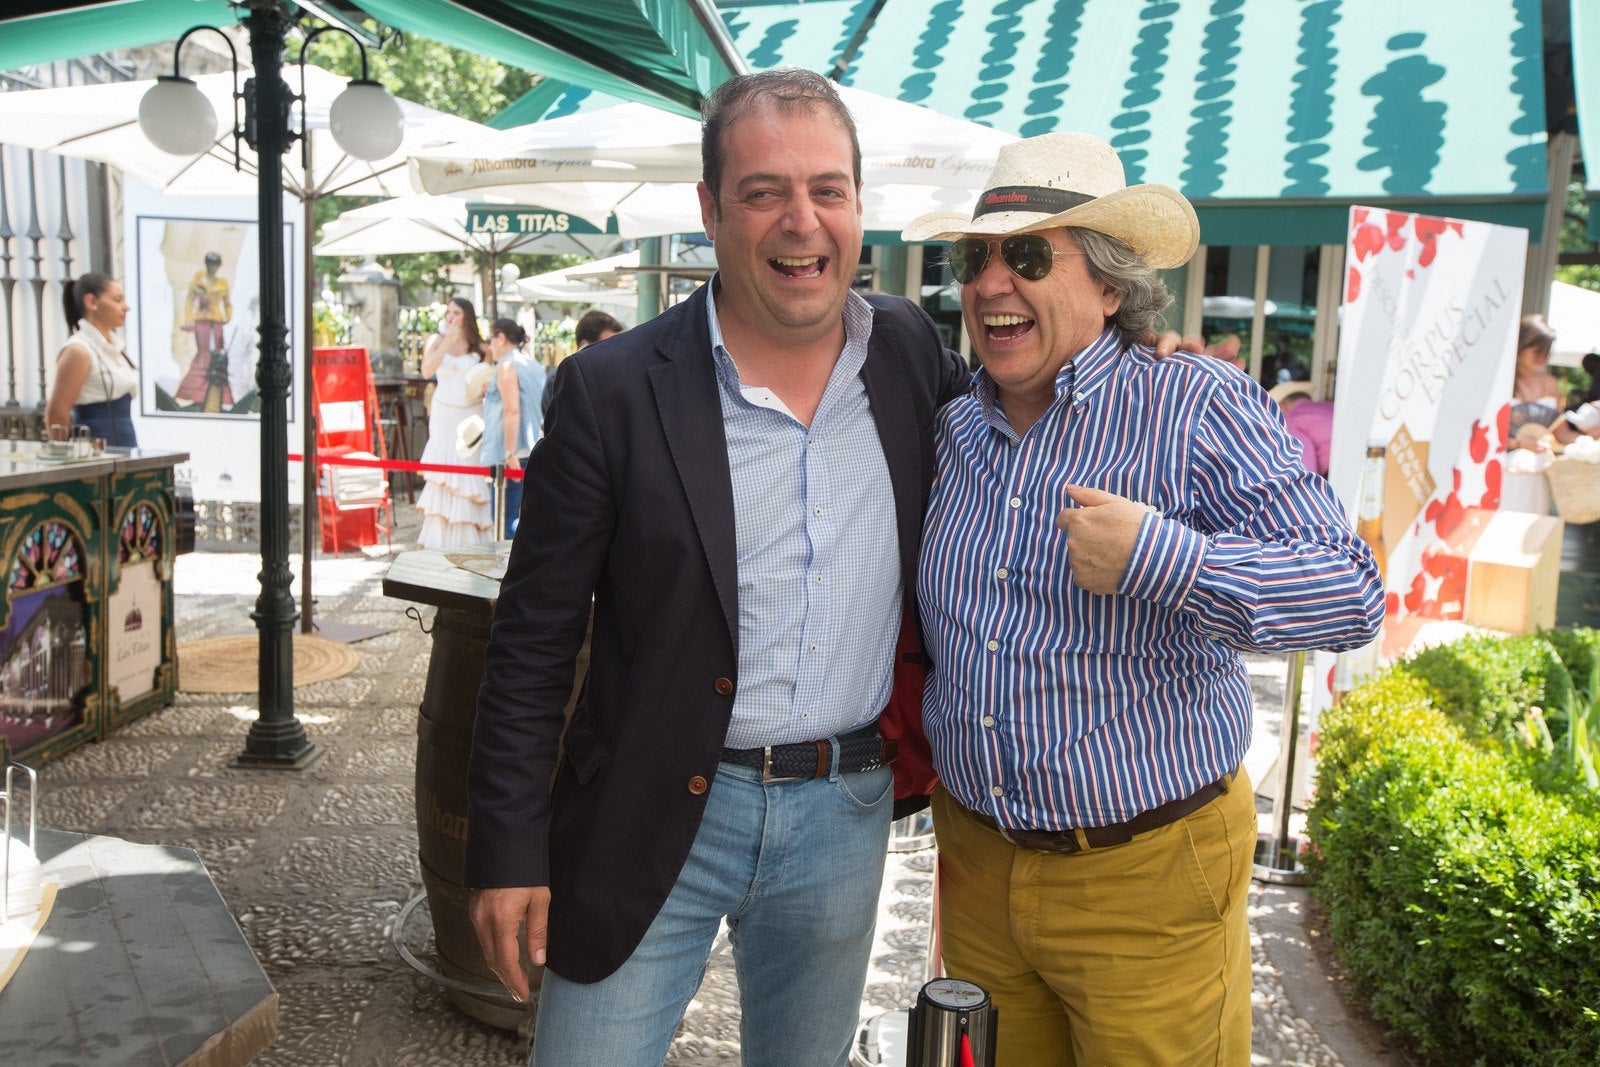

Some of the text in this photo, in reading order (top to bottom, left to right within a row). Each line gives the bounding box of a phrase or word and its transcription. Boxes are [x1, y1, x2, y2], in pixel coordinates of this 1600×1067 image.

[470, 158, 537, 176] Alhambra
[984, 191, 1028, 207] Alhambra
[472, 213, 570, 233] LAS TITAS
[1422, 278, 1511, 405] ESPECIAL
[1380, 297, 1463, 420] CORPUS
